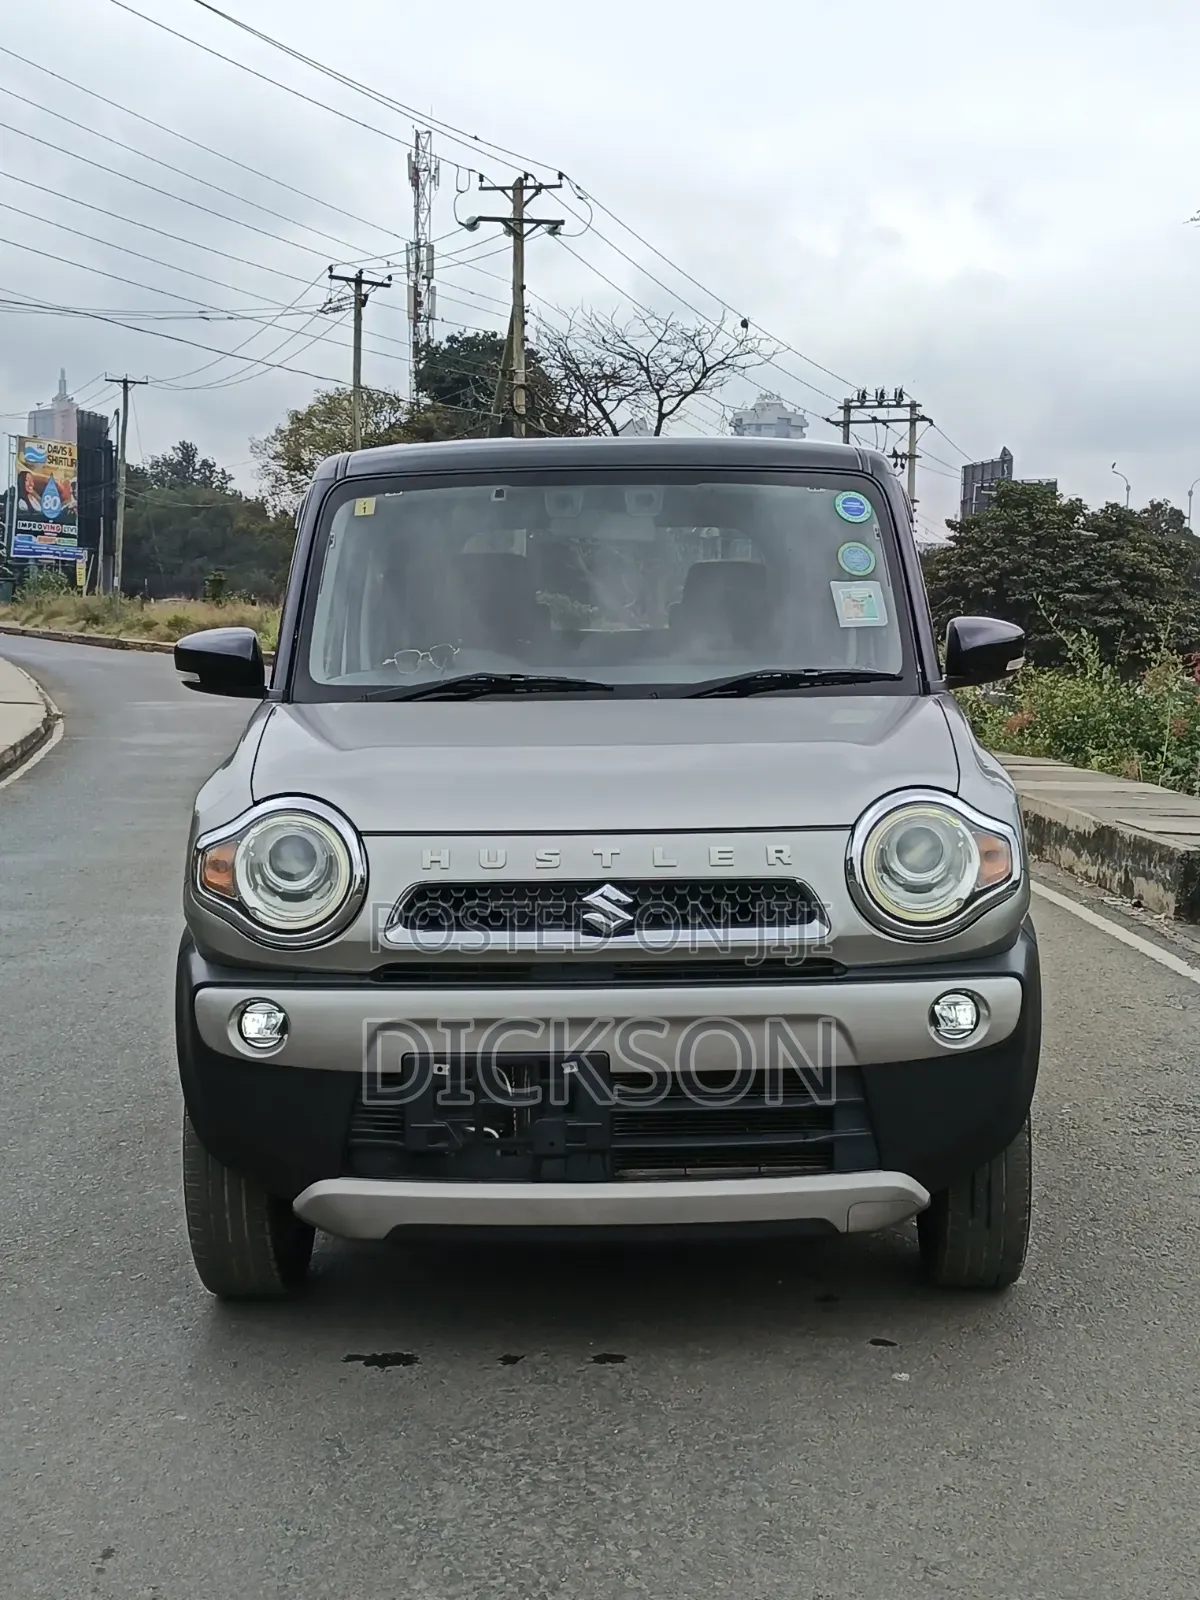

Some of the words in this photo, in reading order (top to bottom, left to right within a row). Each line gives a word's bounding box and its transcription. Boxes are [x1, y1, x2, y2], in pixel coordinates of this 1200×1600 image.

[47, 443, 68, 456] DAVIS
[43, 495, 60, 510] 80
[18, 521, 61, 532] IMPROVING
[421, 844, 793, 871] HUSTLER
